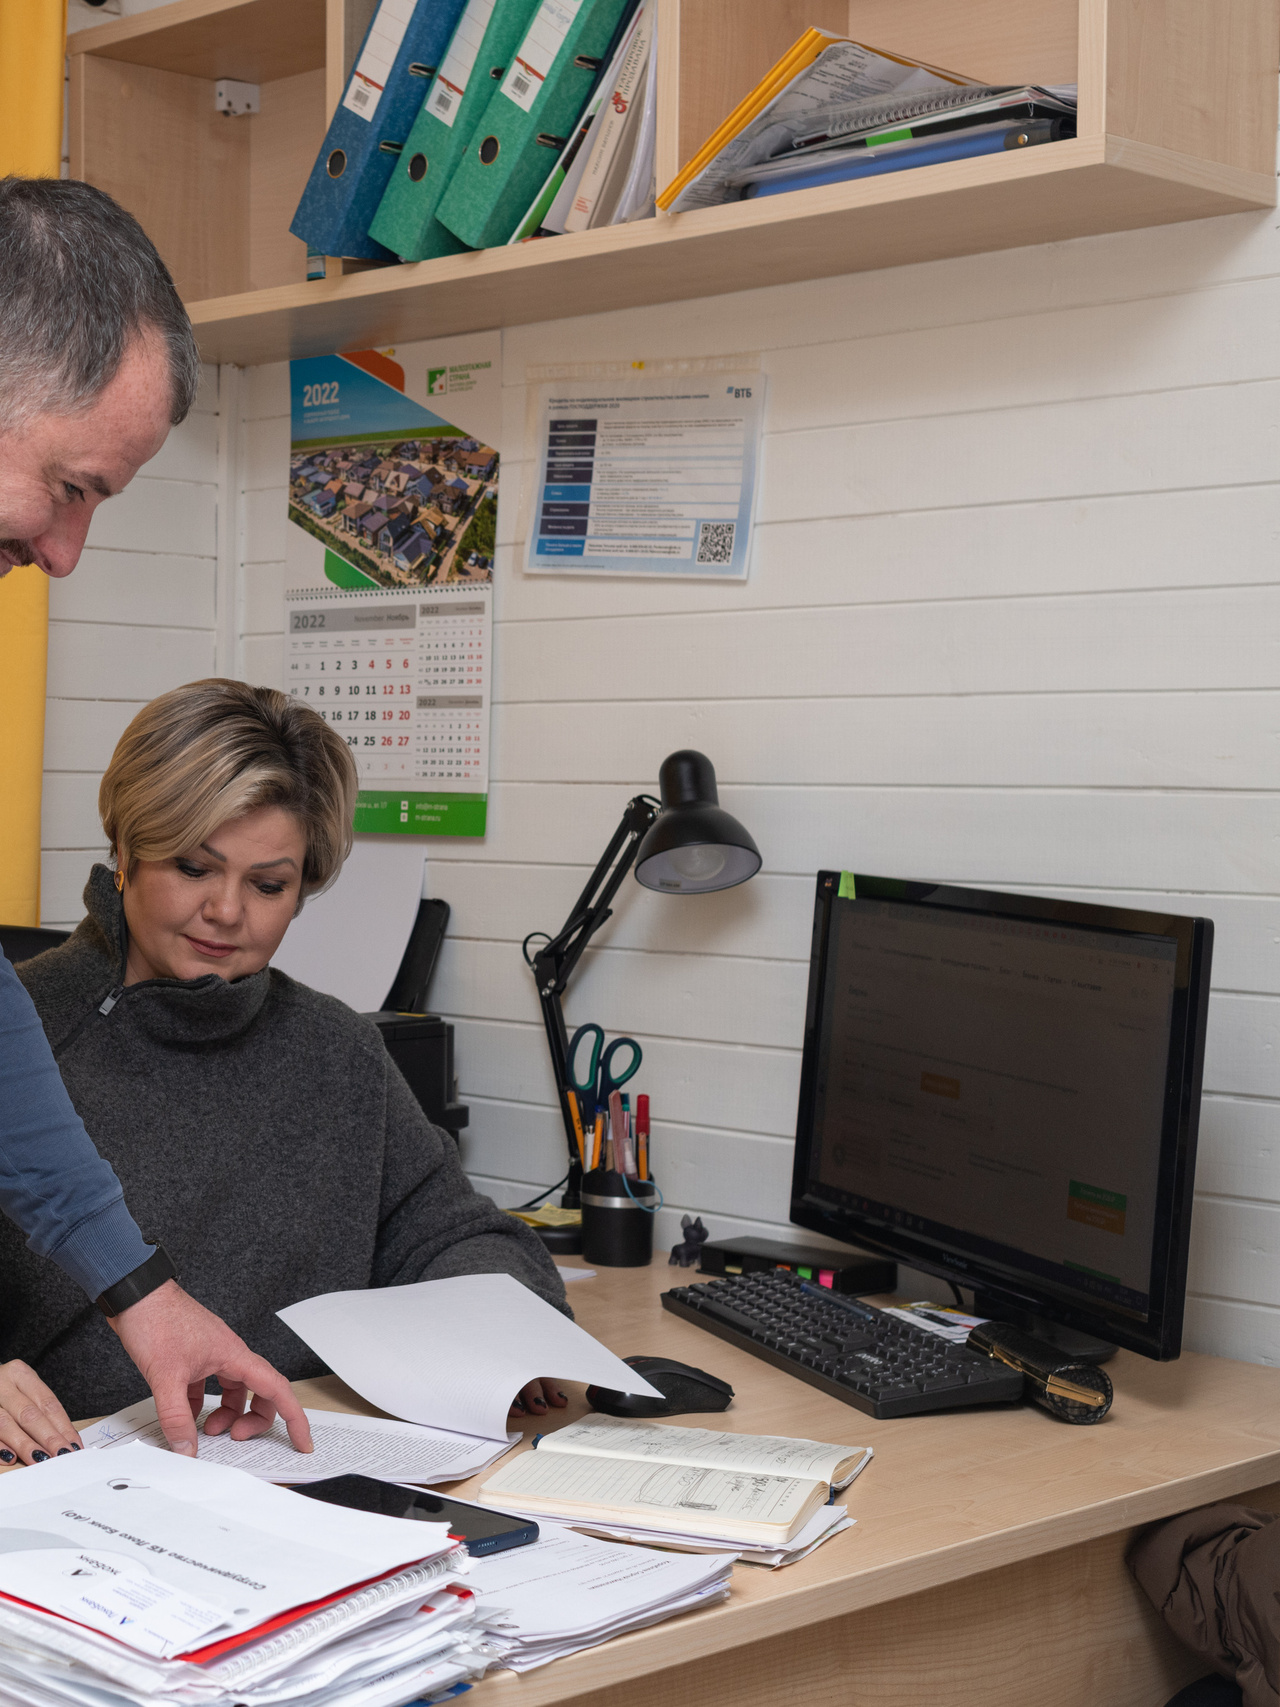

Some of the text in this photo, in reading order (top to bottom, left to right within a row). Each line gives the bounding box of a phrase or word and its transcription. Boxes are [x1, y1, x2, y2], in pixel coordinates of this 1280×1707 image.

[303, 381, 339, 407] 2022
[734, 388, 752, 398] ВТБ
[422, 606, 439, 614] 2022
[294, 614, 326, 629] 2022
[320, 661, 325, 671] 1
[336, 661, 341, 670] 2
[352, 660, 358, 670] 3
[368, 660, 375, 669] 4
[386, 659, 392, 669] 5
[403, 659, 409, 669] 6
[304, 687, 310, 696] 7
[319, 686, 325, 696] 8
[334, 686, 340, 695] 9
[349, 686, 360, 695] 10
[366, 686, 376, 695] 11
[383, 685, 394, 695] 12
[400, 685, 411, 695] 13
[418, 698, 436, 706] 2022
[332, 711, 342, 721] 16
[348, 711, 359, 721] 17
[365, 711, 376, 721] 18
[382, 711, 393, 721] 19
[399, 710, 410, 720] 20
[347, 736, 409, 746] 24 25 26 27
[61, 1509, 267, 1590] Сотрудничество КБ Локо Банк (АО)
